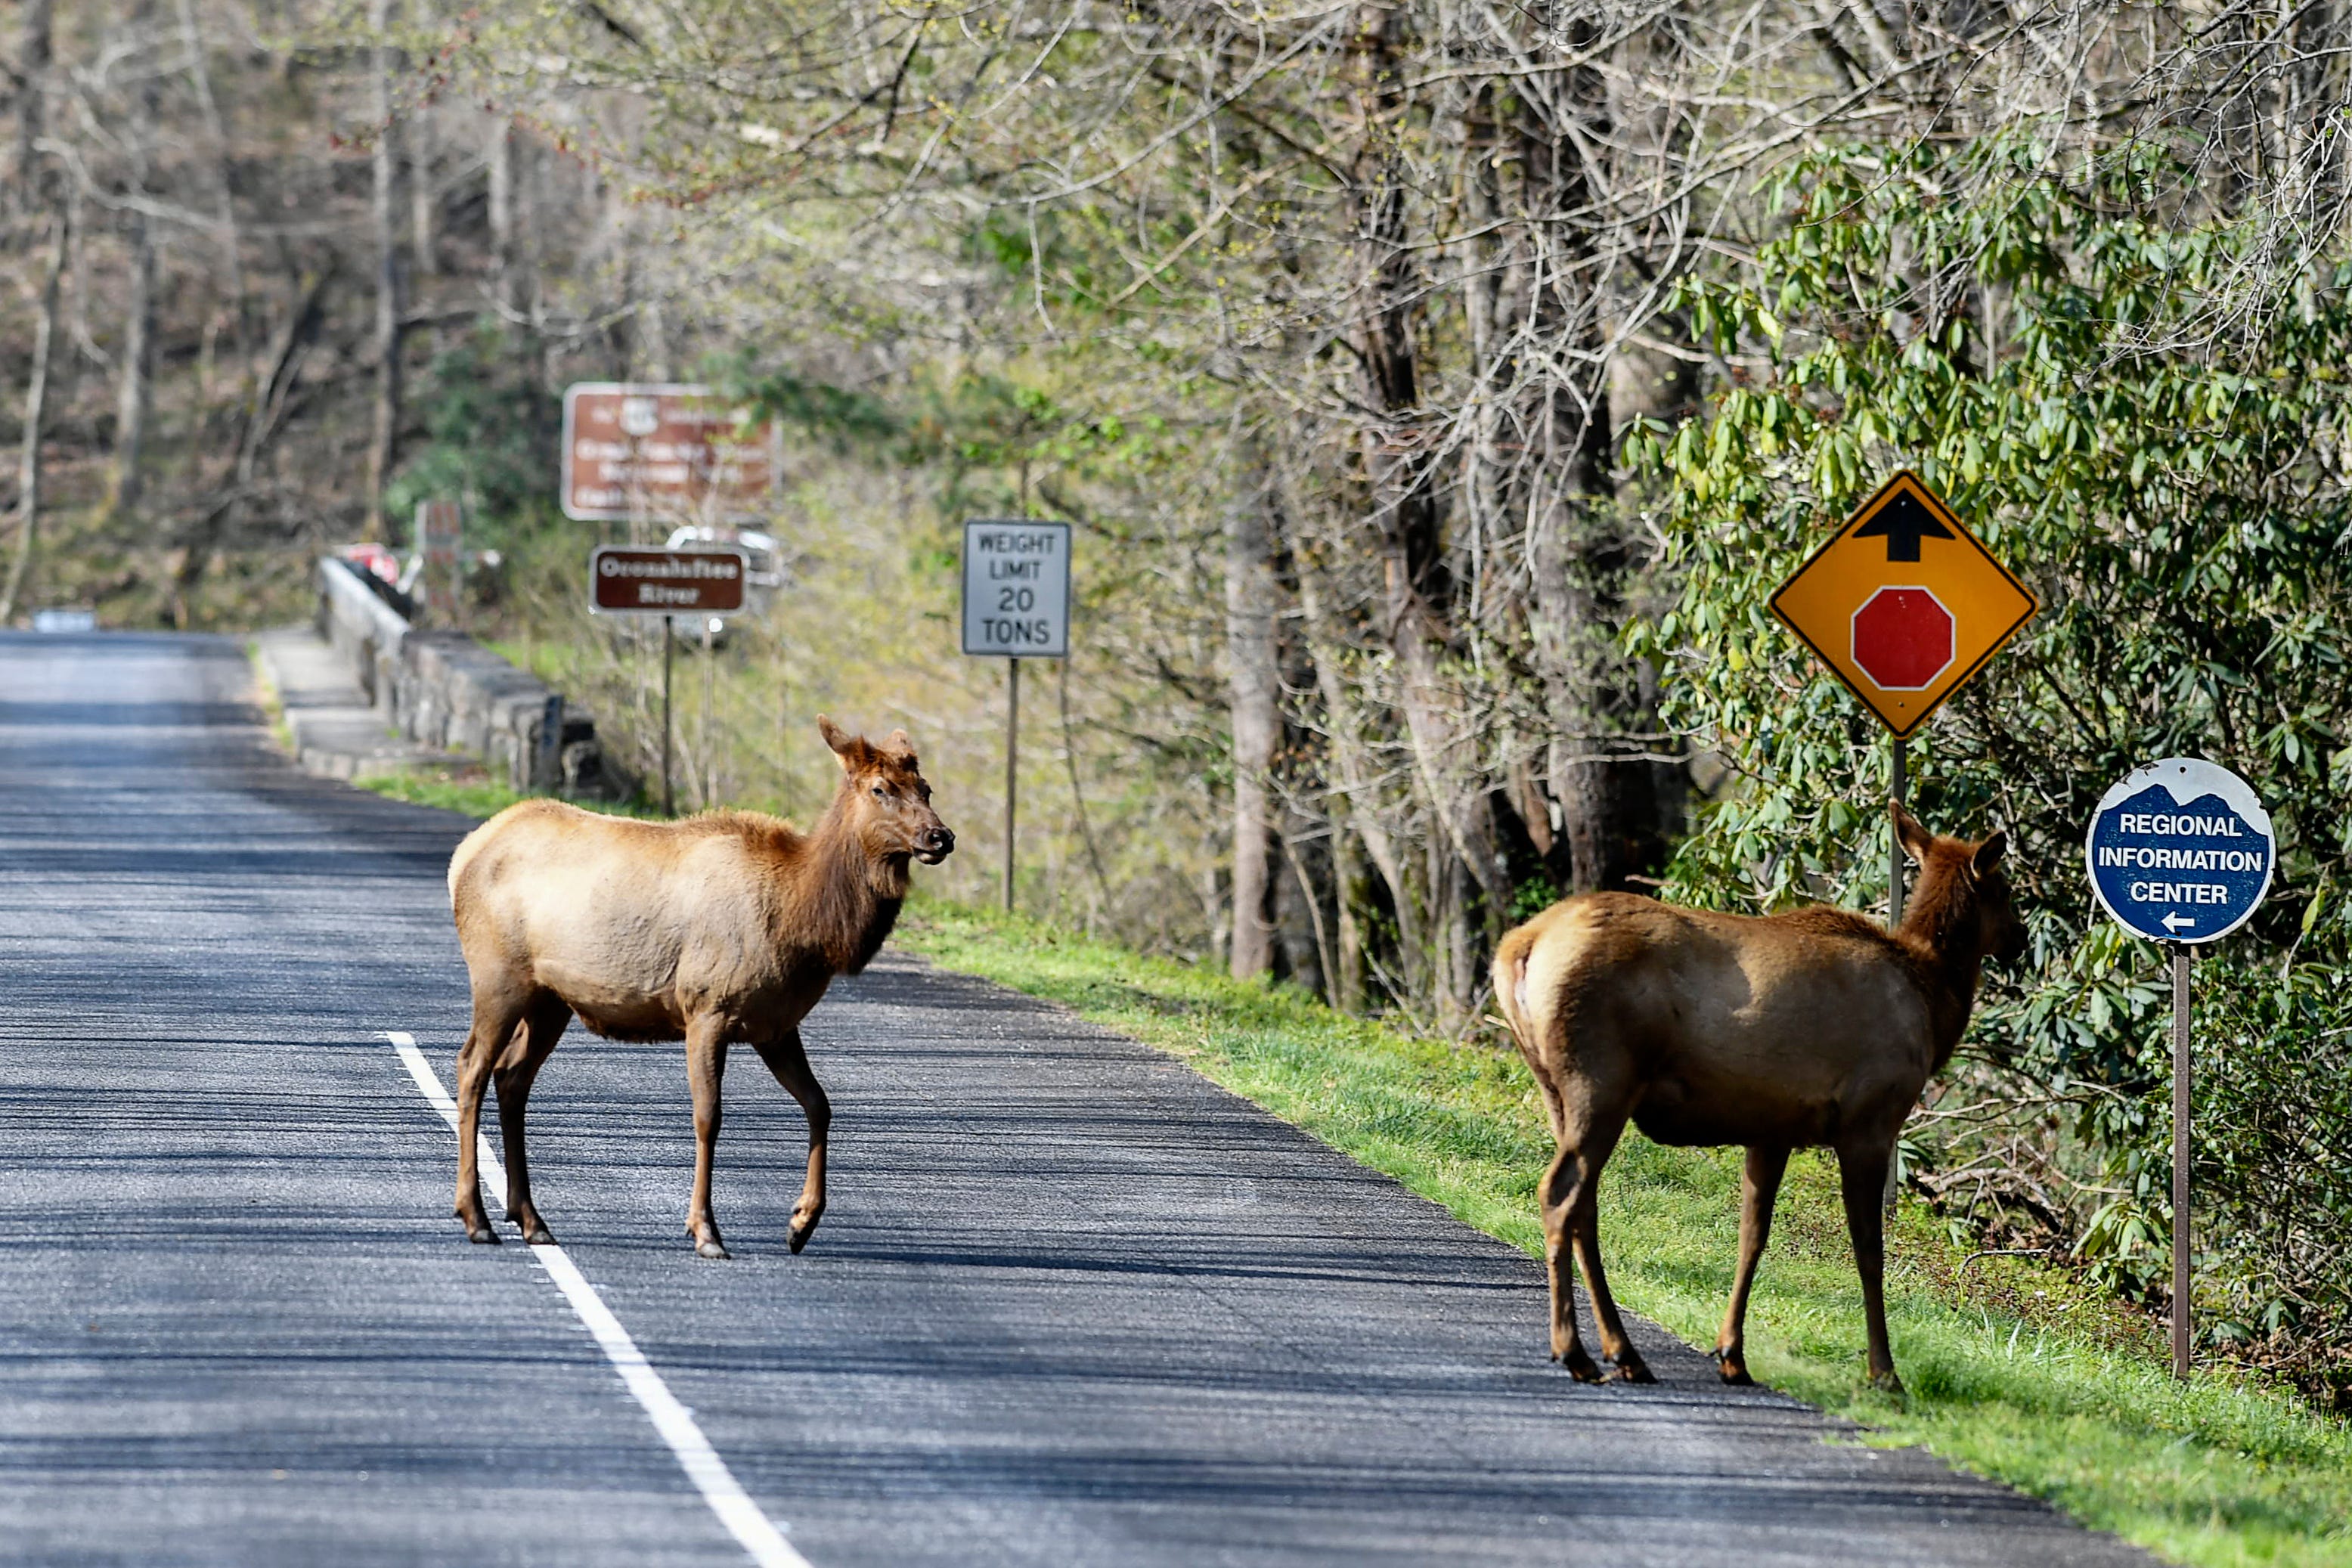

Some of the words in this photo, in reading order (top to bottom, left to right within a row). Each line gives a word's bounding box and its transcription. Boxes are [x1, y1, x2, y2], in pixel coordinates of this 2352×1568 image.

[980, 534, 1054, 553] WEIGHT
[990, 561, 1040, 580] LIMIT
[639, 584, 699, 603] River
[999, 587, 1033, 612] 20
[982, 619, 1050, 644] TONS
[2120, 814, 2242, 836] REGIONAL
[2099, 848, 2262, 871] INFORMATION
[2130, 882, 2227, 903] CENTER
